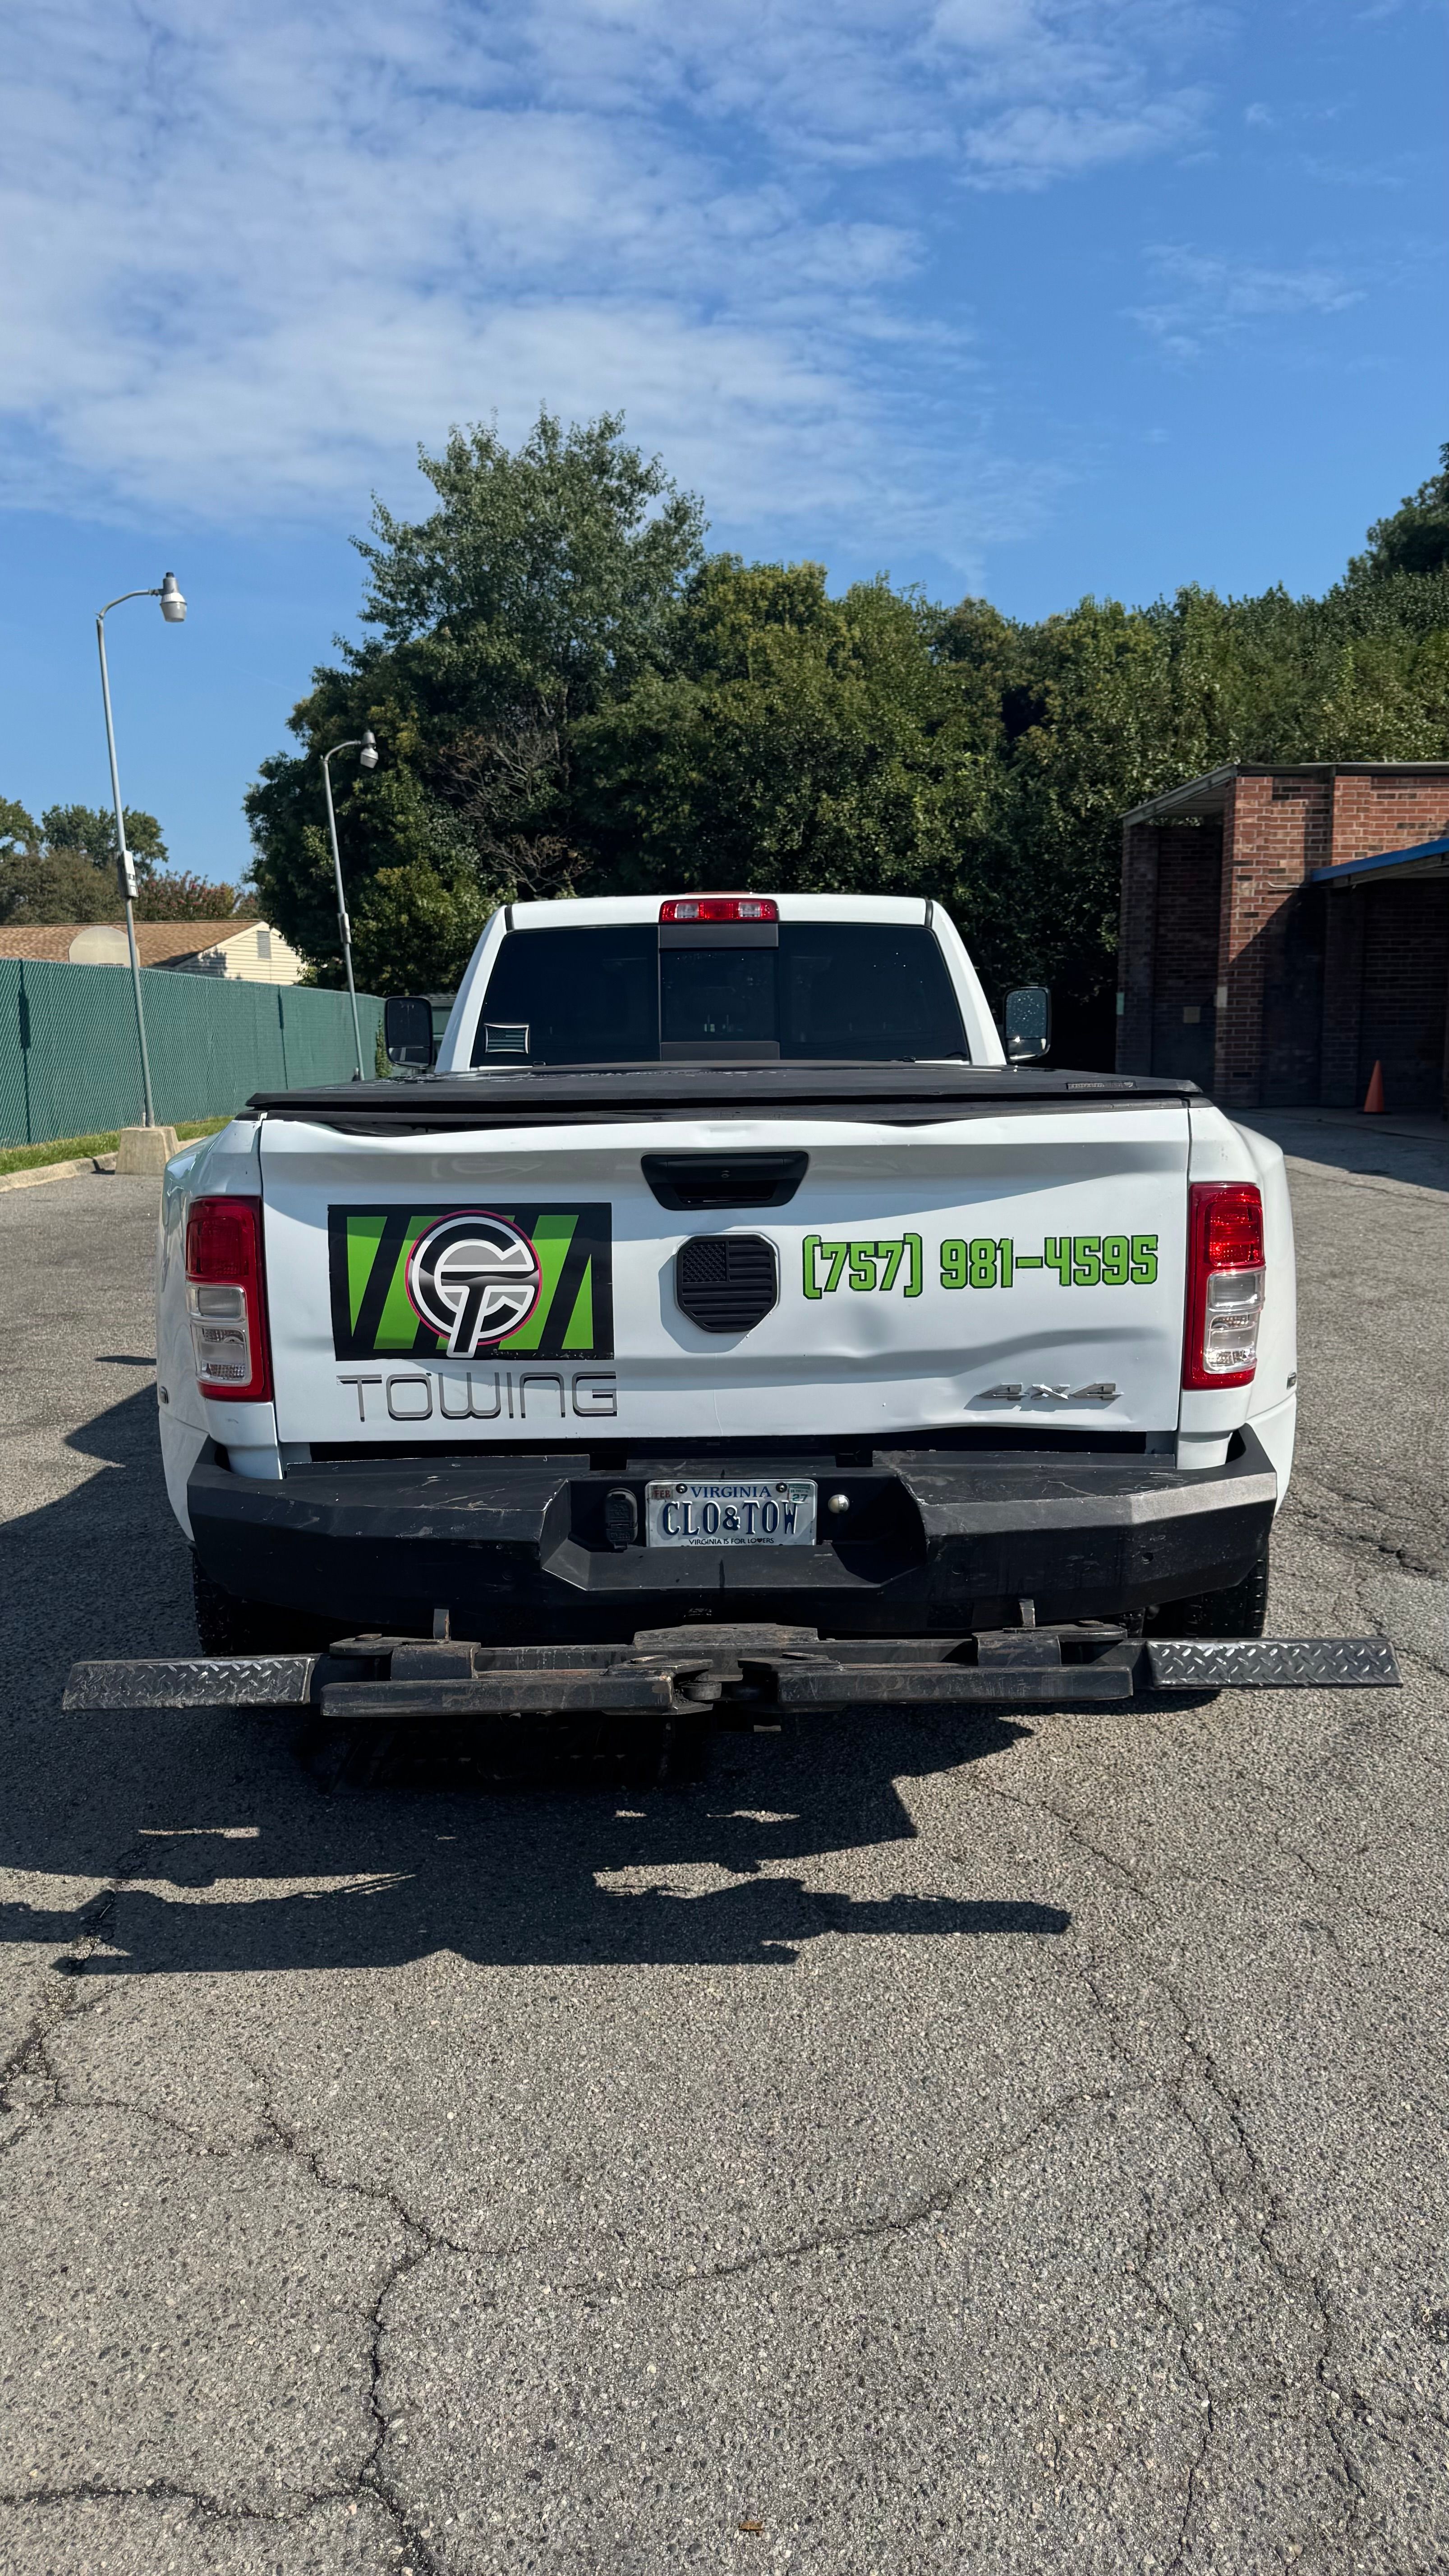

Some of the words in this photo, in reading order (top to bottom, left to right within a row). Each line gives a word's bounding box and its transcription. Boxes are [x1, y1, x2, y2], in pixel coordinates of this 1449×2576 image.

[940, 1234, 1159, 1289] 981-4595
[336, 1371, 617, 1422] TOWING
[654, 1490, 671, 1498] FEB
[690, 1486, 772, 1498] VIRGINIA
[792, 1494, 808, 1502] 27
[663, 1500, 798, 1536] CLO&TOW
